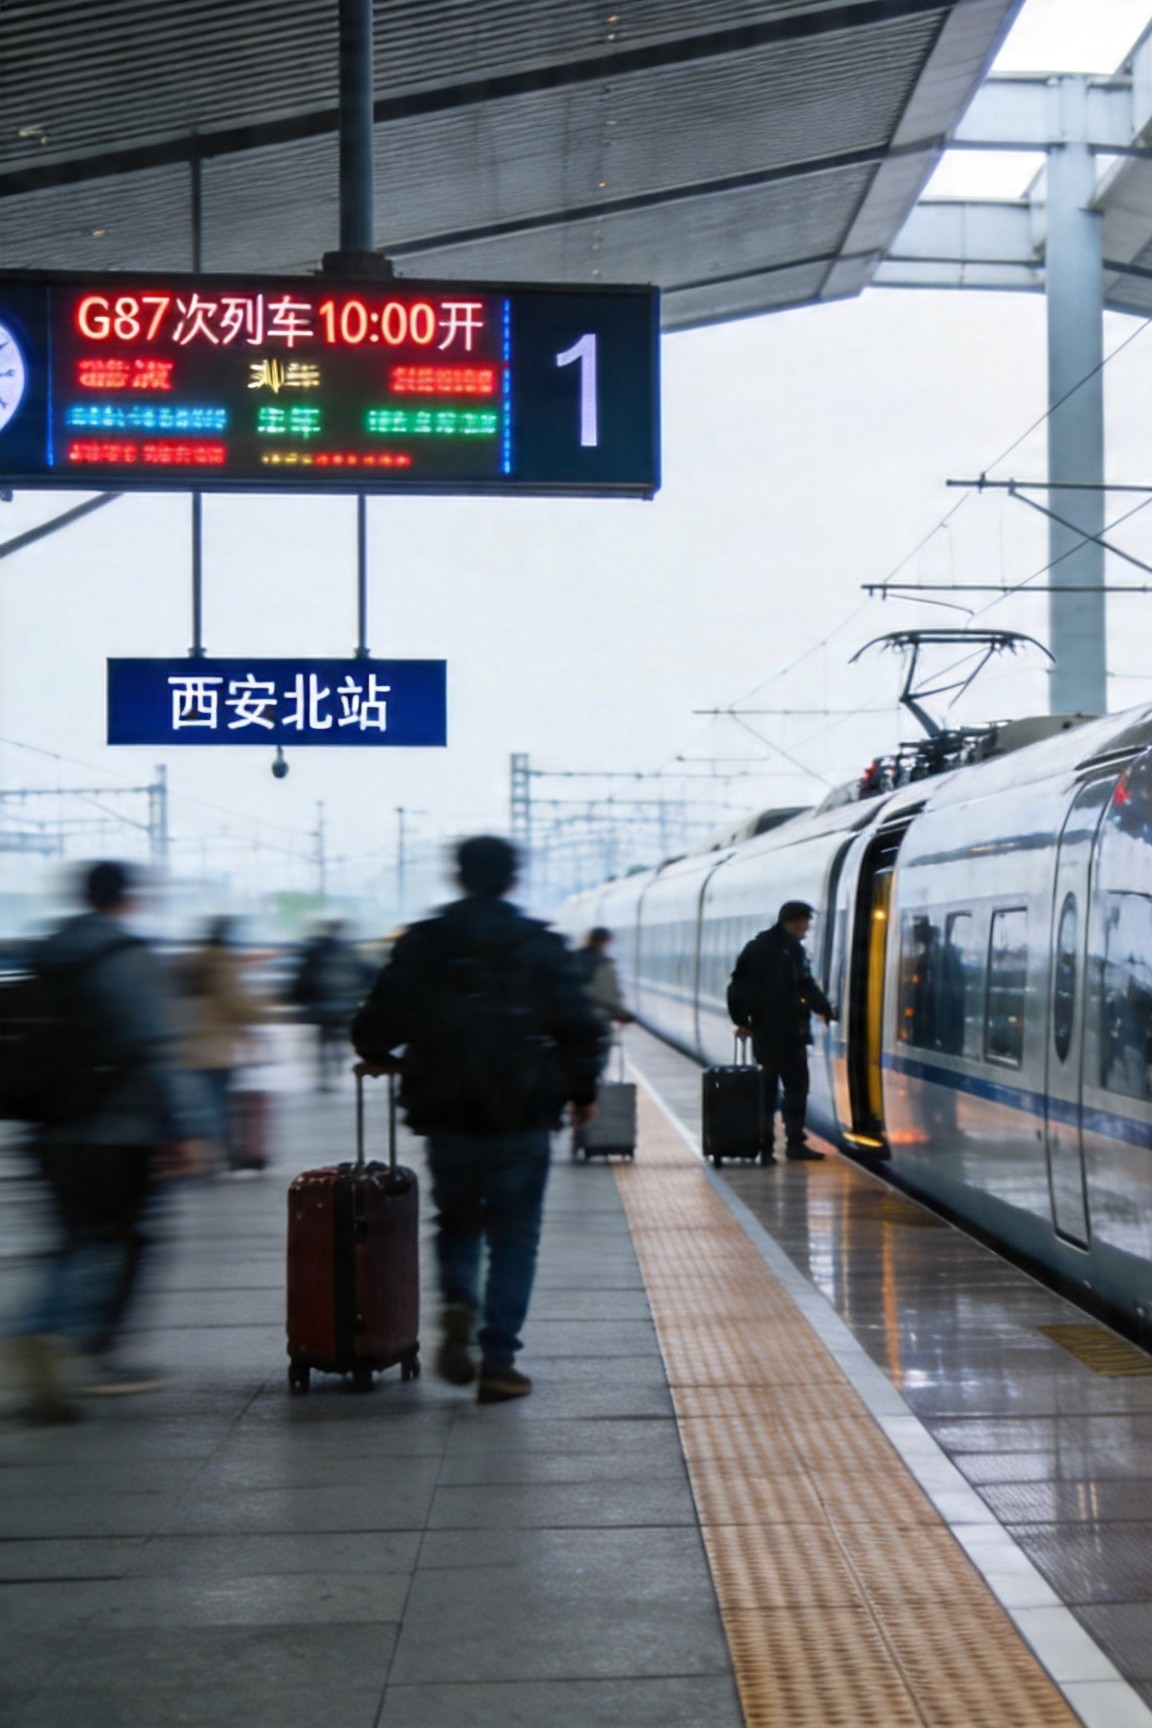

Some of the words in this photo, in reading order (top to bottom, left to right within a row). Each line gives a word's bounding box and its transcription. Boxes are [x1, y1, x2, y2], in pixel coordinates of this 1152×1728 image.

[75, 294, 485, 351] G87次列车10:00开
[555, 333, 599, 448] 1
[168, 673, 391, 731] 西安北站
